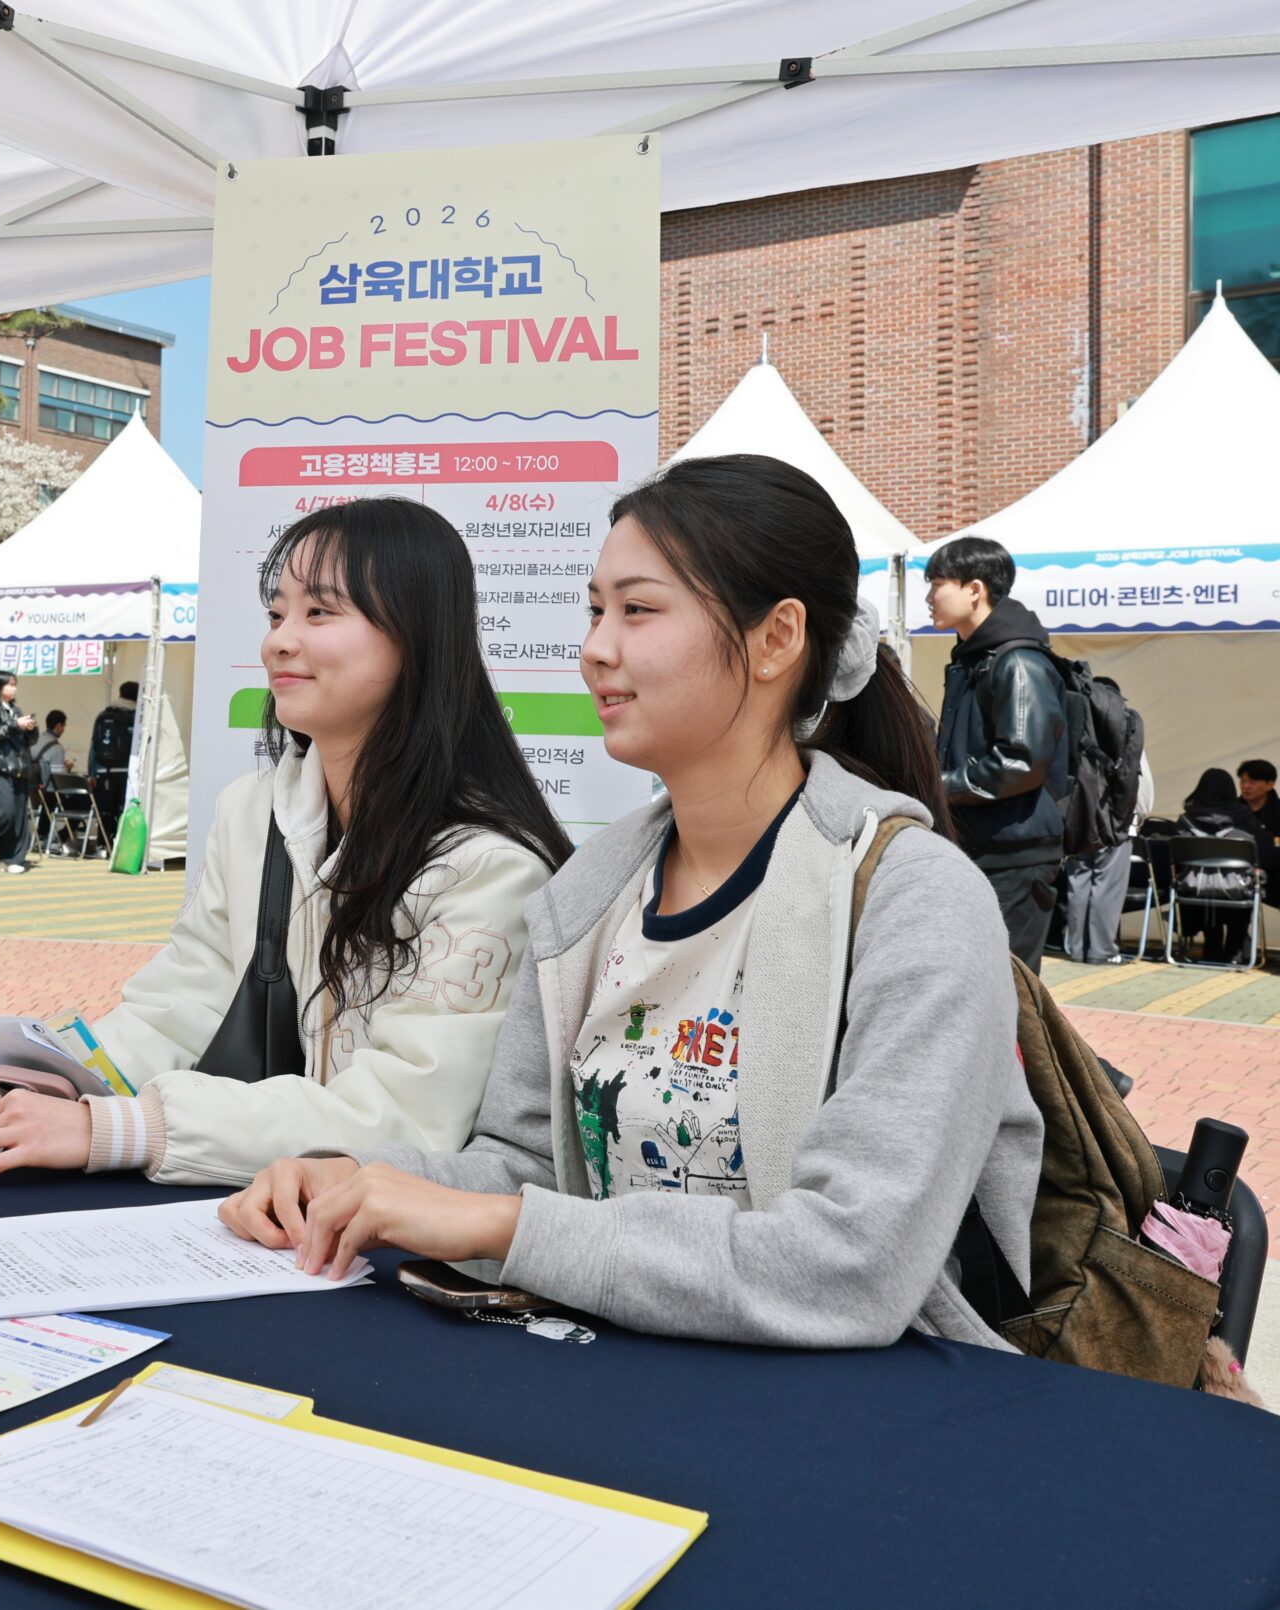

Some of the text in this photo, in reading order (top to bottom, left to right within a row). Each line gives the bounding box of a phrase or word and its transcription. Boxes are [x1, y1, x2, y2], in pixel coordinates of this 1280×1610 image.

[369, 205, 491, 235] 2026
[318, 253, 544, 305] 삼육대학교
[226, 314, 640, 374] JOB FESTIVAL
[298, 452, 442, 478] 고용정책홍보
[453, 455, 498, 473] 12:00
[516, 453, 560, 471] 17:00
[485, 493, 556, 512] 4/8(수)
[1166, 549, 1190, 560] JOB
[1190, 547, 1244, 559] FESTIVAL
[1046, 584, 1239, 608] 미디어·콘텐츠·엔터
[28, 612, 86, 624] YOUNGLIM
[66, 642, 102, 668] 상담
[487, 643, 582, 660] 육군사관학교
